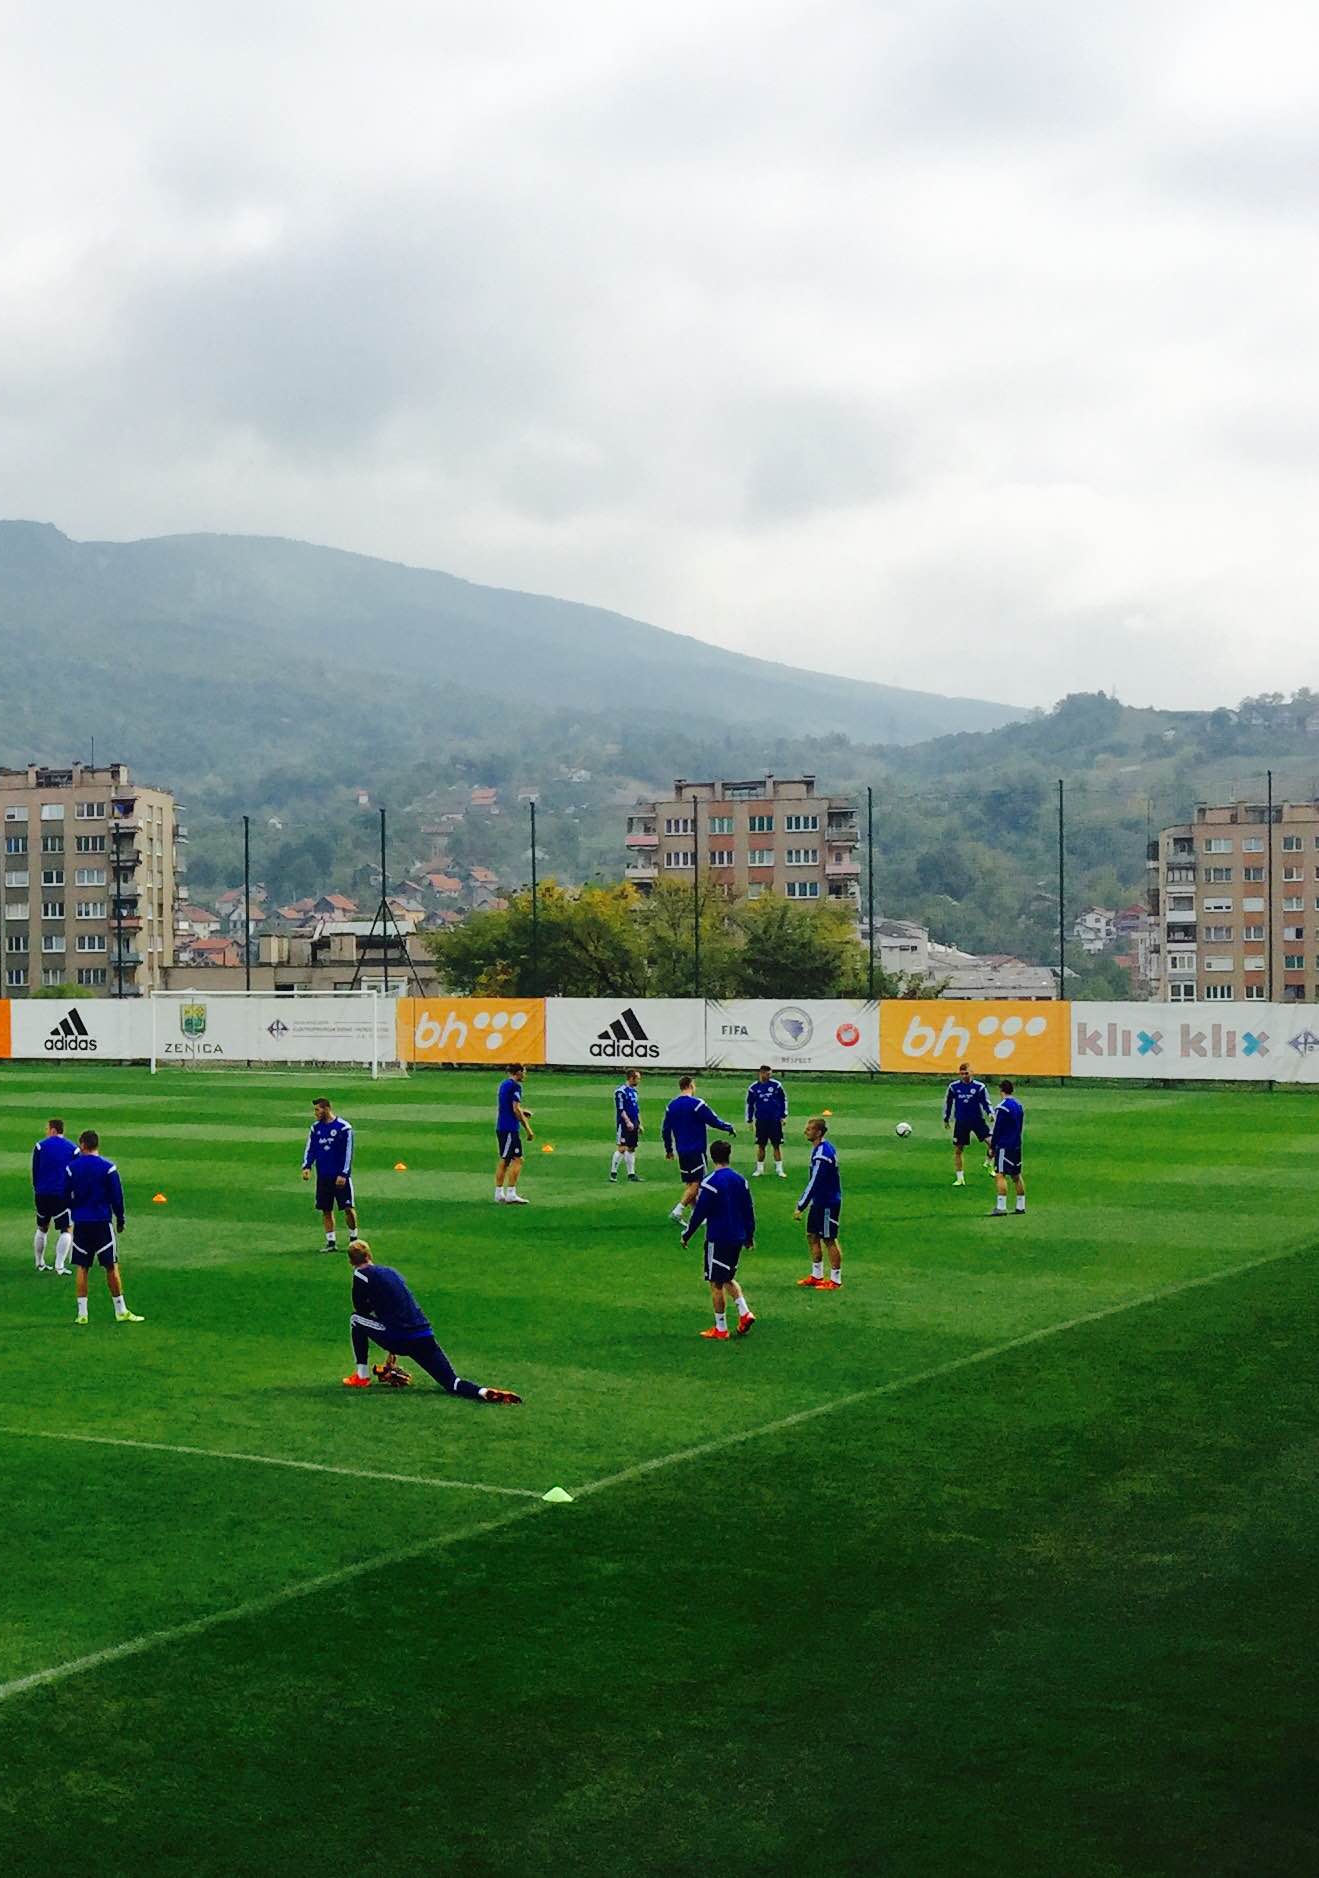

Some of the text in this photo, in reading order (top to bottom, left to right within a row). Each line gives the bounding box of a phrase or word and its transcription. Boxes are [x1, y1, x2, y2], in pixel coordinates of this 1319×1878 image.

[414, 1011, 468, 1049] bh
[721, 1025, 749, 1036] FIFA
[902, 1015, 971, 1057] bh
[44, 1035, 98, 1052] adidas
[164, 1043, 224, 1054] ZENICA
[589, 1039, 660, 1058] adidas
[1077, 1022, 1270, 1058] klix klix
